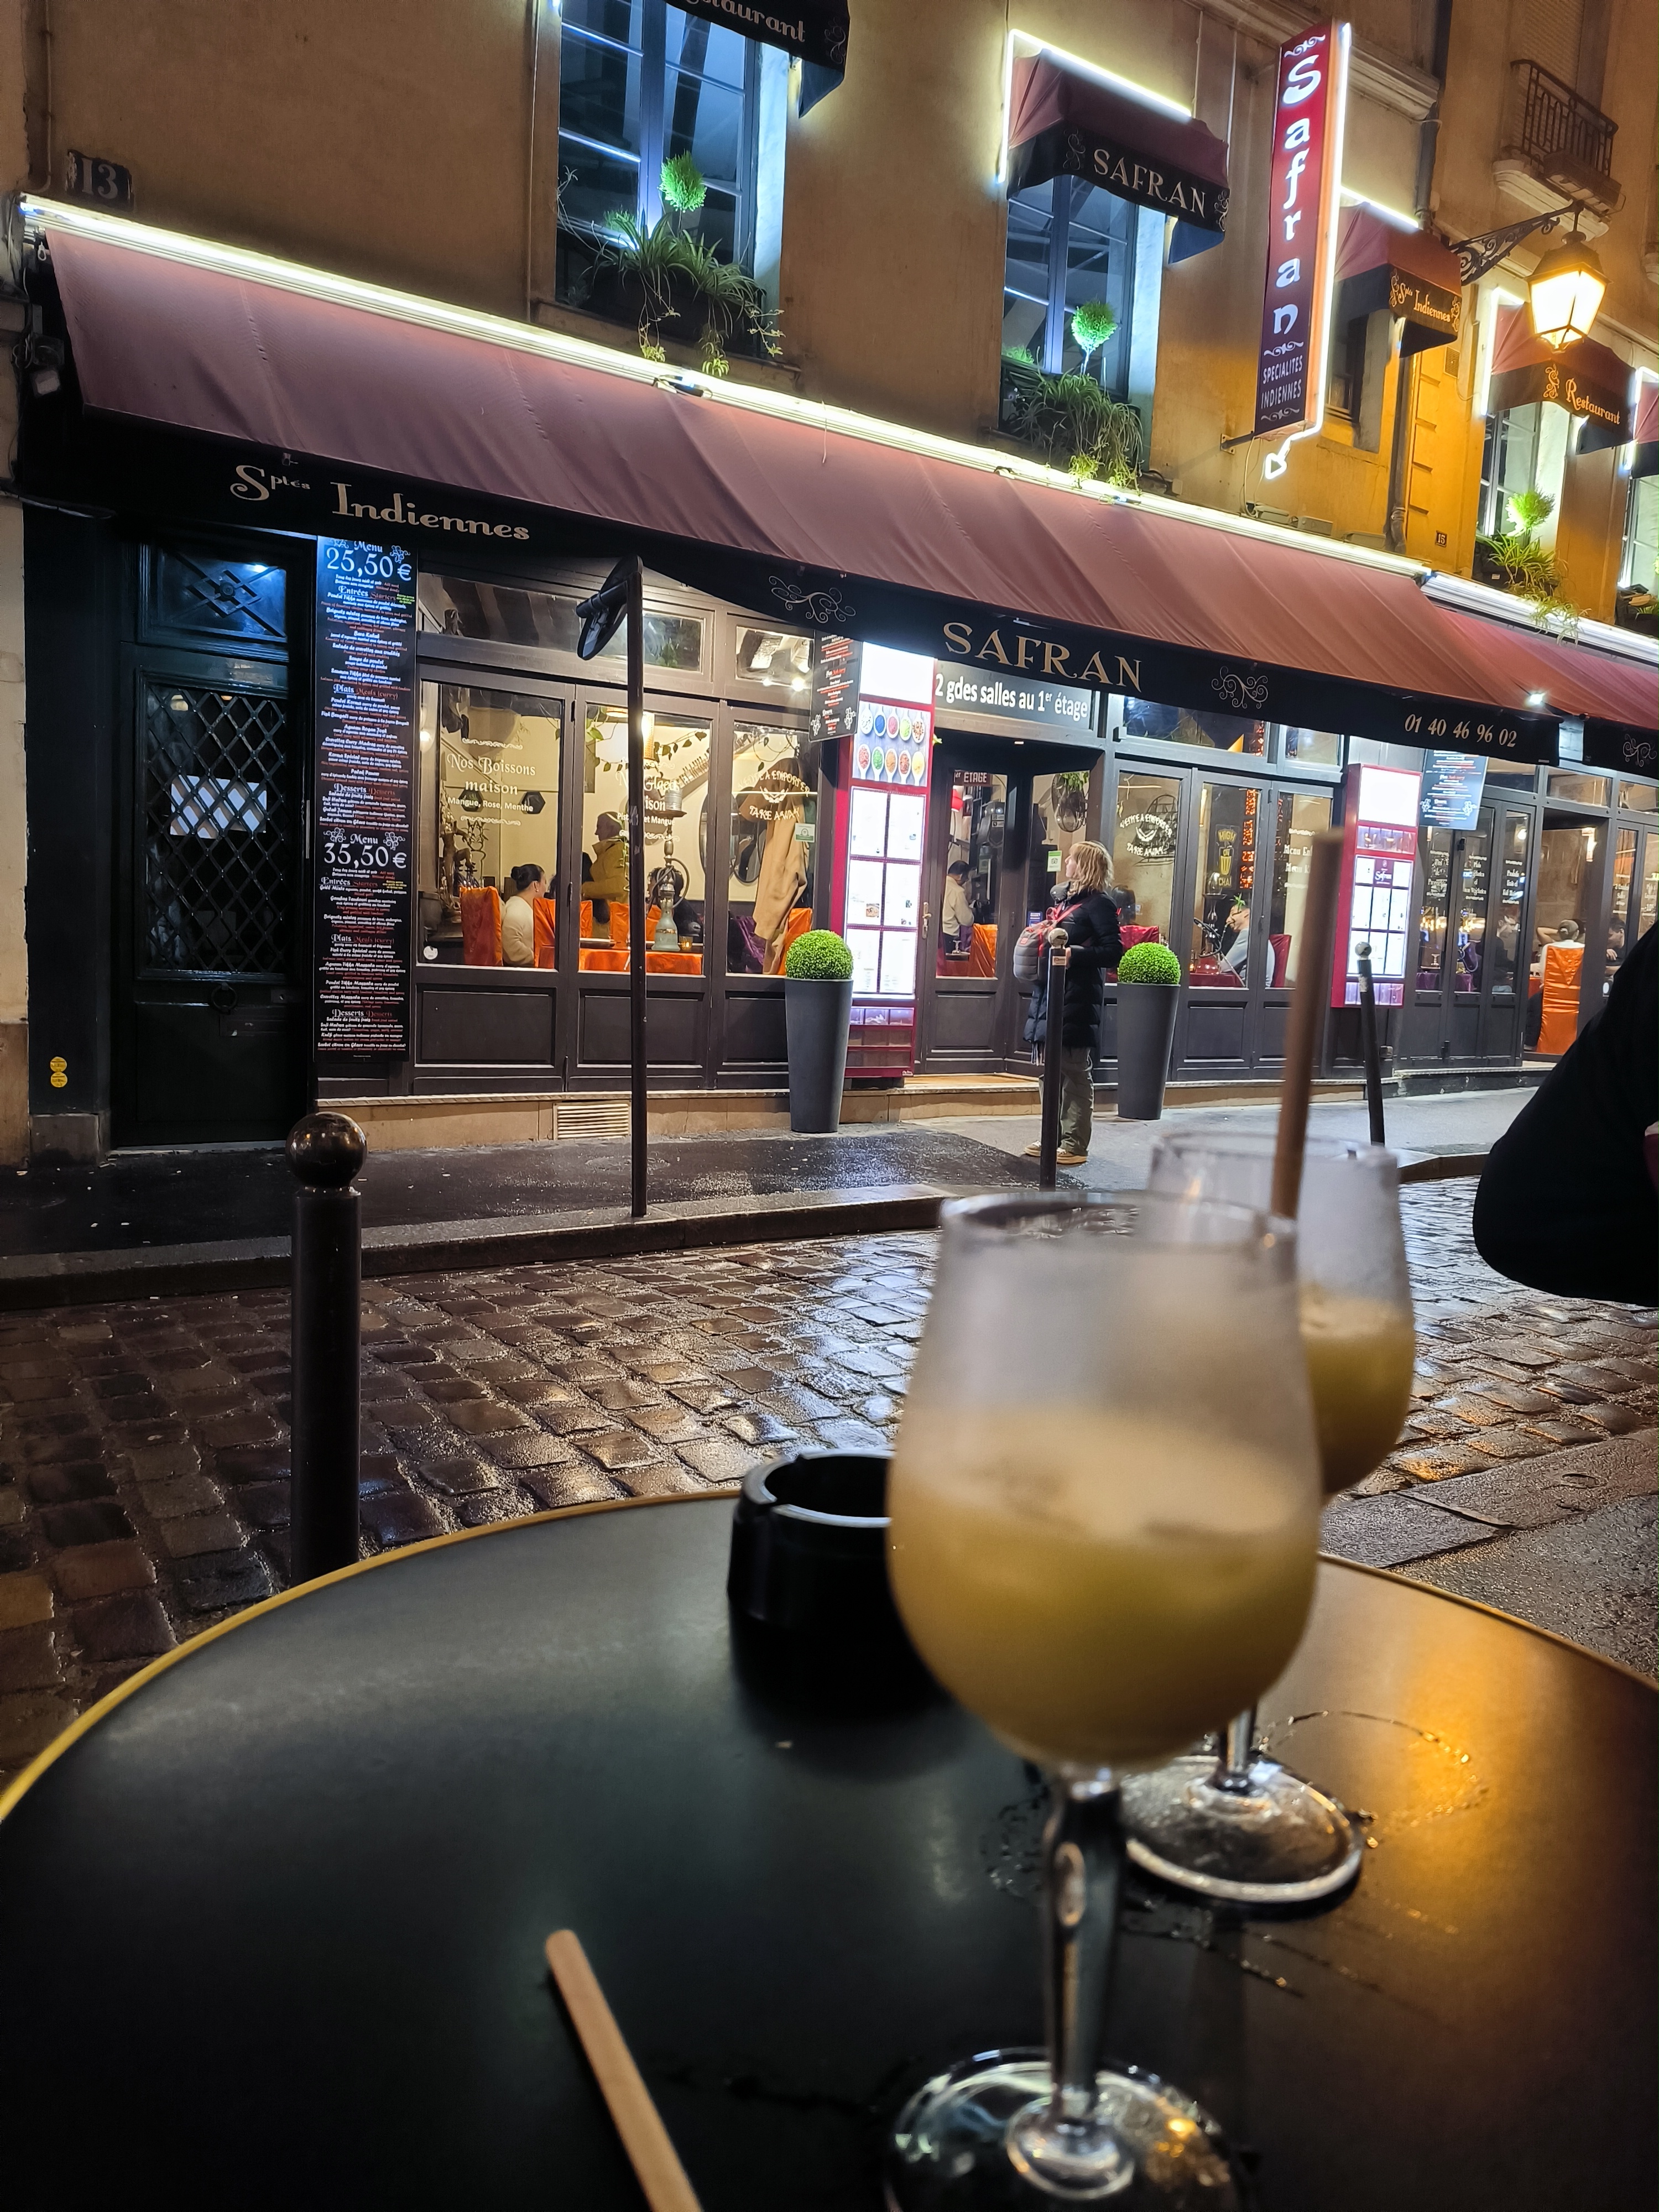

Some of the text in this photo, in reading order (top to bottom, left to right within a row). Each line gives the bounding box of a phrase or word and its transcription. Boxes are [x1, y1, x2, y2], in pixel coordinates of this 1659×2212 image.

[81, 158, 118, 200] 13
[1094, 149, 1207, 218] SAFRAN
[1273, 54, 1322, 335] Safran
[1413, 290, 1451, 322] Indiennes
[1262, 355, 1303, 384] SPECIALITES
[1261, 379, 1302, 409] INDIENNES
[1566, 378, 1620, 425] Restaurant
[330, 482, 530, 540] Indiennes
[354, 541, 383, 553] Menu
[1438, 534, 1445, 544] 15
[338, 585, 368, 597] Entrées
[371, 592, 396, 602] Starters
[943, 622, 1141, 693] SAFRAN
[333, 684, 354, 693] Plats
[935, 673, 1088, 722] 2 gdes salles au 1er étage
[1405, 714, 1517, 748] 01 40 46 96 02
[447, 754, 536, 776] Nos Boissons
[333, 783, 367, 793] Desserts
[465, 780, 518, 795] maison
[771, 770, 810, 797] EMPORTER
[447, 797, 534, 812] Mangue, Rose, Menthe
[645, 795, 666, 811] ison
[749, 805, 800, 821] TAKE AWAY
[651, 816, 675, 827] Mangue
[1120, 813, 1140, 828] VENTE
[1145, 813, 1173, 838] EMPORTER
[350, 833, 378, 844] Menu
[1218, 831, 1236, 842] HIGH
[1126, 842, 1164, 857] TAKE AWAY
[321, 877, 351, 886] Entrées
[1218, 878, 1232, 886] CHAI
[331, 933, 352, 942] Plats
[332, 1009, 364, 1018] Desserts
